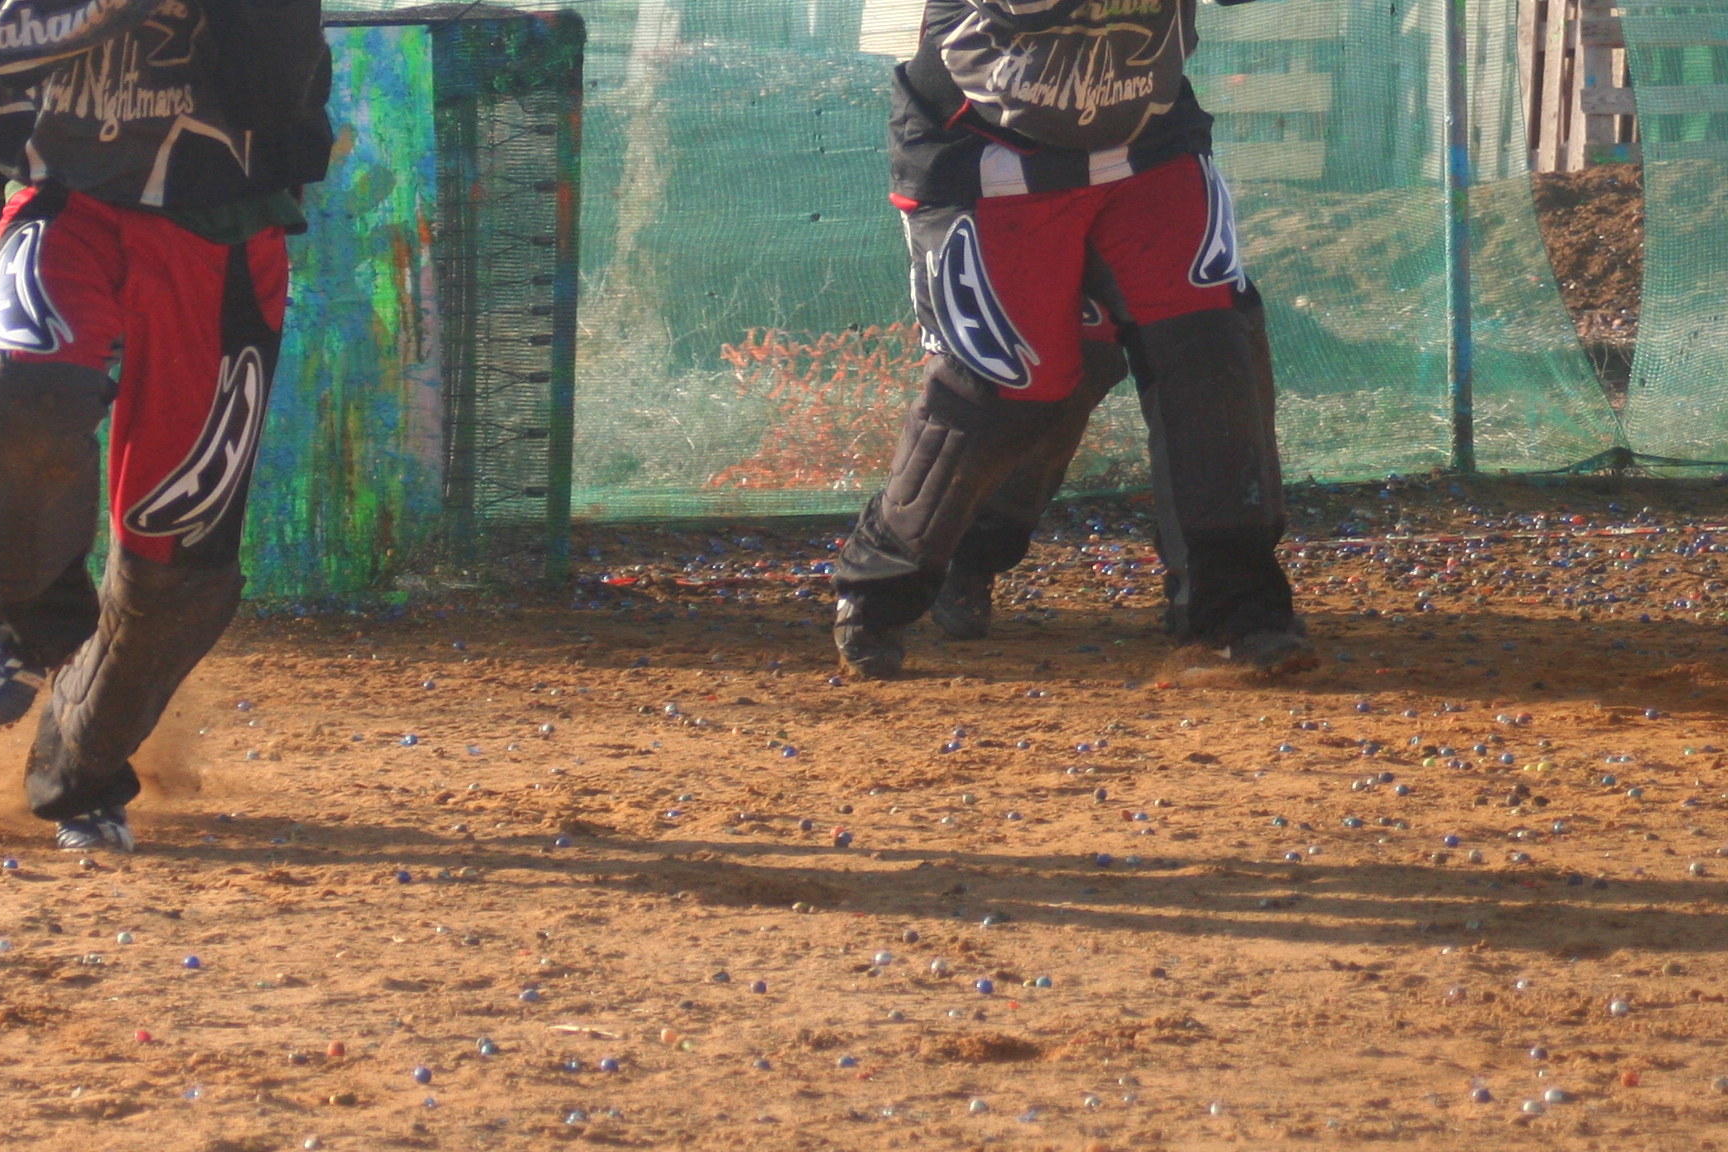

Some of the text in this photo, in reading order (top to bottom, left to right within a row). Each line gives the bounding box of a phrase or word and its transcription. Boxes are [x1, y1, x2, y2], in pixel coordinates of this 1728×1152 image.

[75, 31, 195, 142] Nightmares
[986, 35, 1154, 126] Madrid Nightmares
